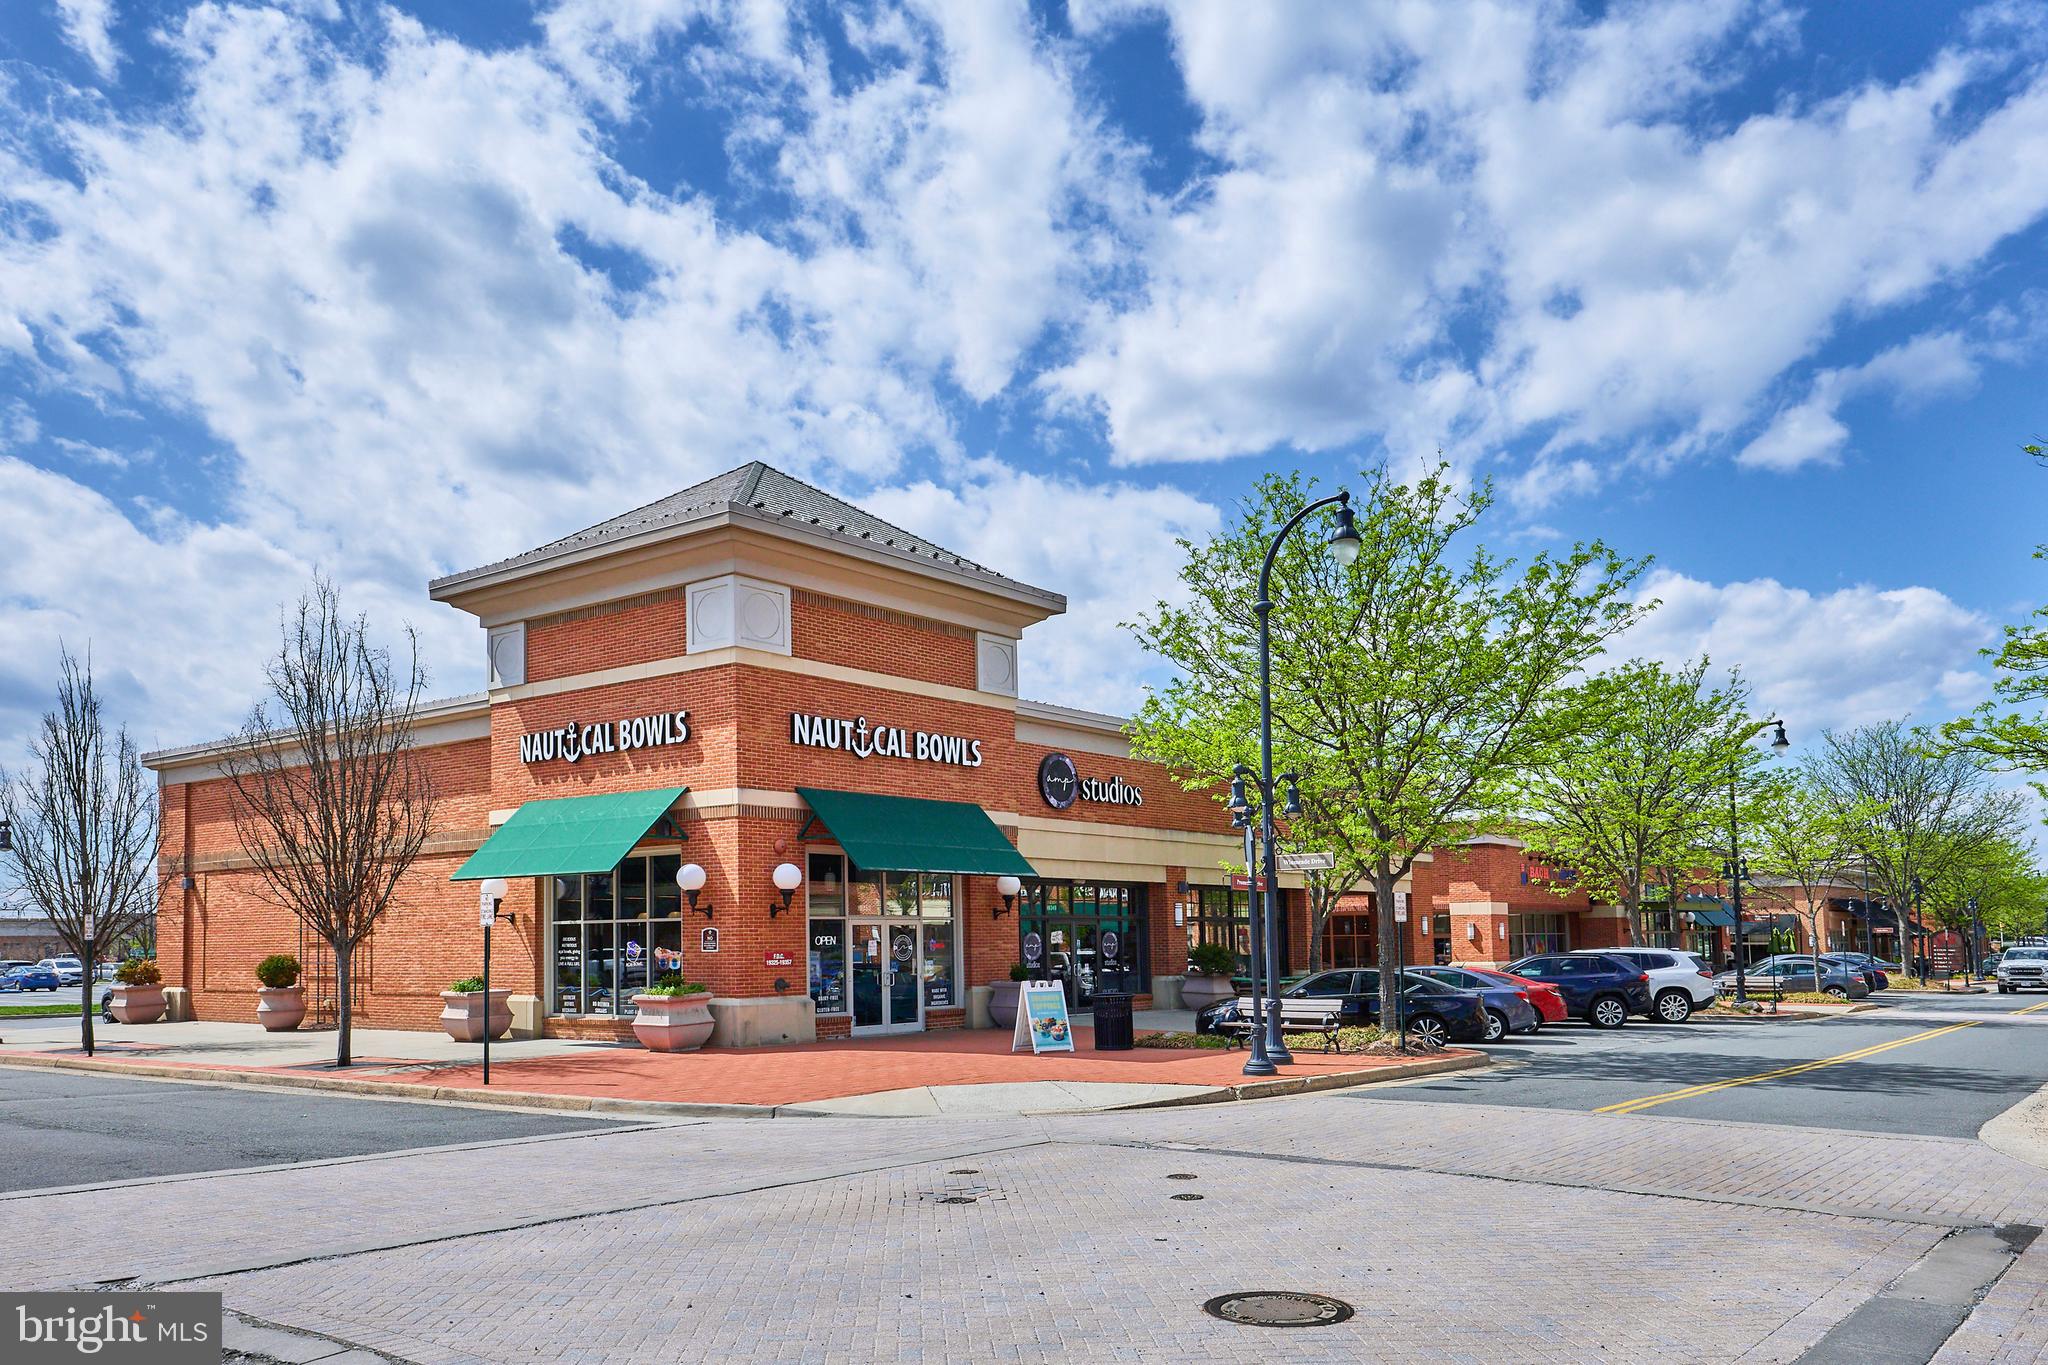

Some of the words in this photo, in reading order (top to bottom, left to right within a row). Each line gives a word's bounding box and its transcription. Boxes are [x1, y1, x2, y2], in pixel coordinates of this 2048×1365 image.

[619, 711, 688, 750] BOWLS
[916, 731, 982, 767] BOWLS
[1047, 774, 1075, 791] amp
[1082, 776, 1143, 806] studios
[815, 935, 837, 946] OPEN
